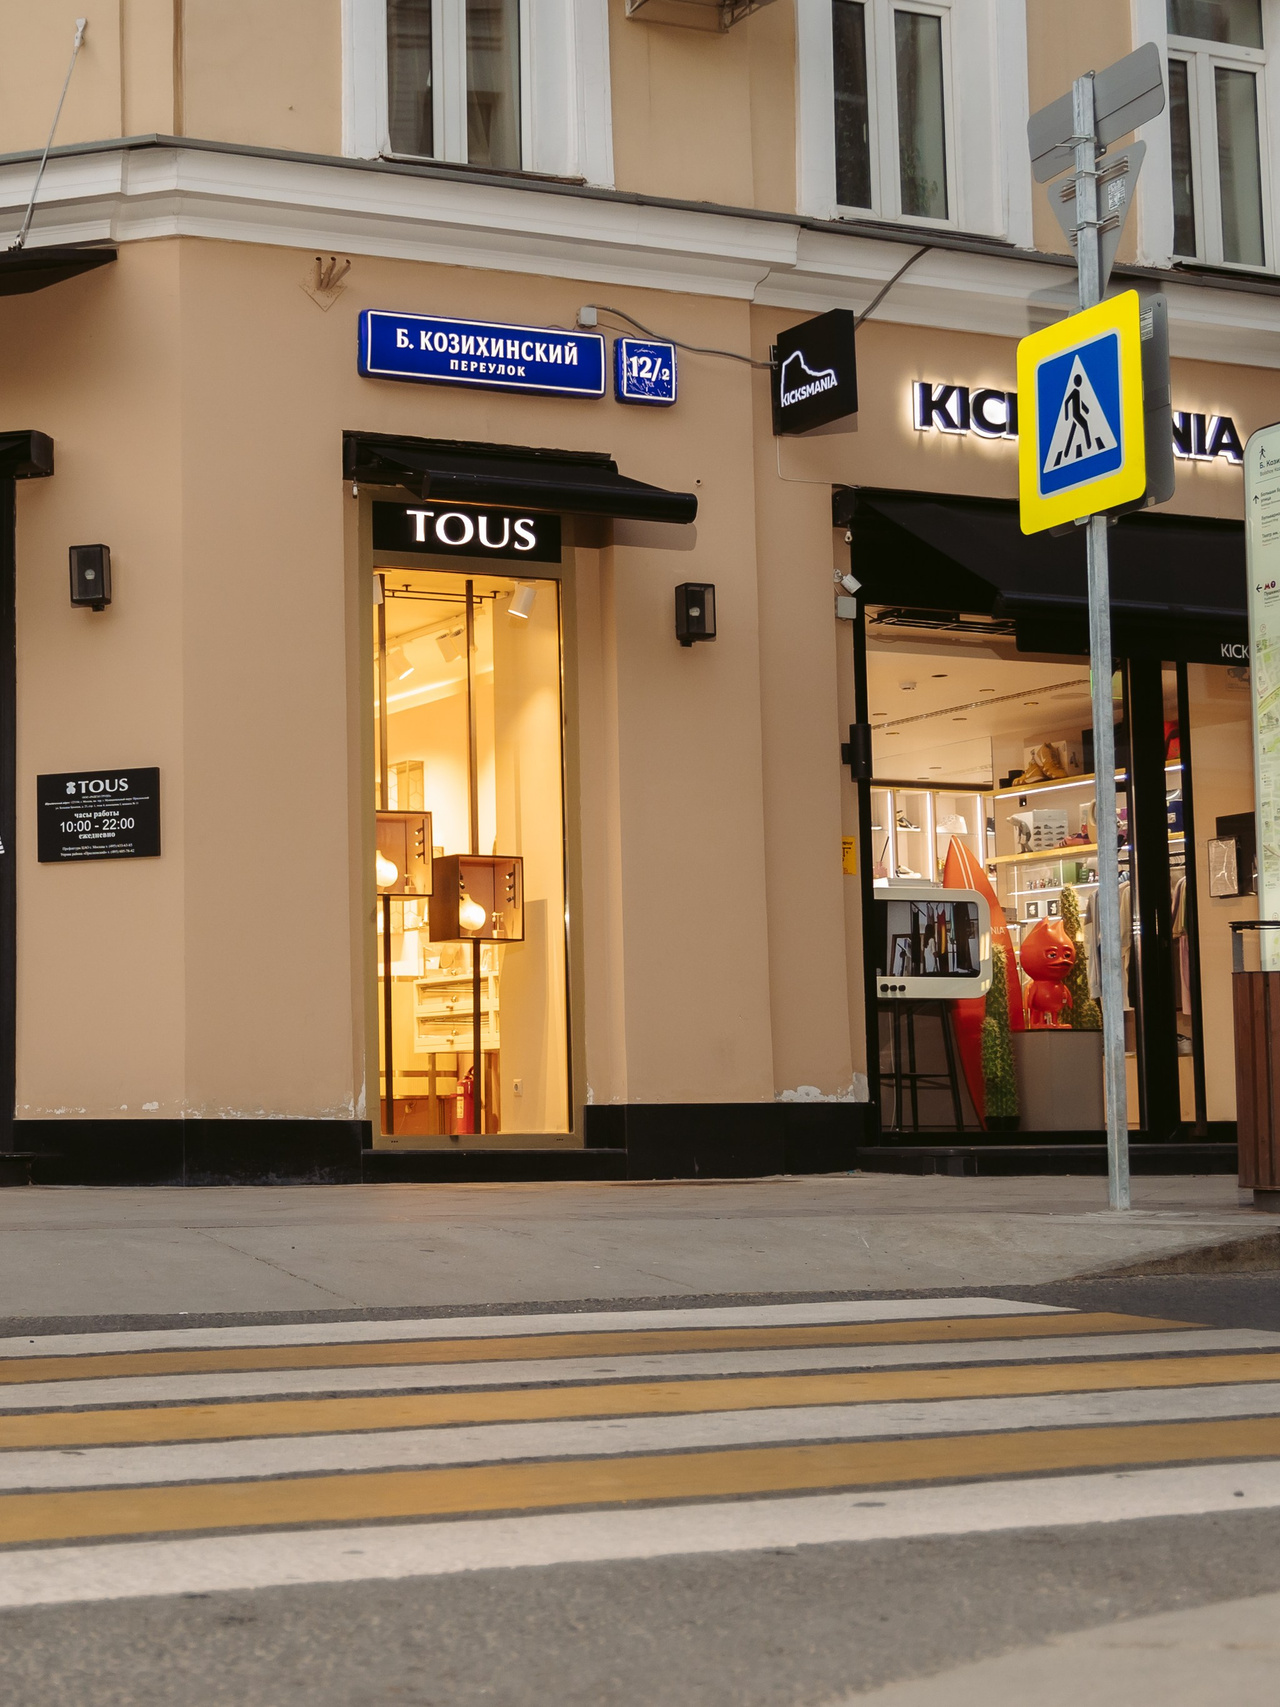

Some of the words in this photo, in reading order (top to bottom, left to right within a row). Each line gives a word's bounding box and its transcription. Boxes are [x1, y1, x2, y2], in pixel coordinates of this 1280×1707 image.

[396, 328, 415, 349] Б.
[420, 330, 579, 366] КОЗИХИНСКИЙ
[450, 359, 527, 377] ПЕРЕУЛОК
[629, 355, 671, 382] 12/2
[781, 373, 839, 408] KICKSMANIA
[406, 509, 537, 551] TOUS
[78, 778, 128, 793] TOUS
[60, 820, 91, 832] 10:00
[102, 818, 134, 830] 22:00
[93, 810, 120, 819] работы
